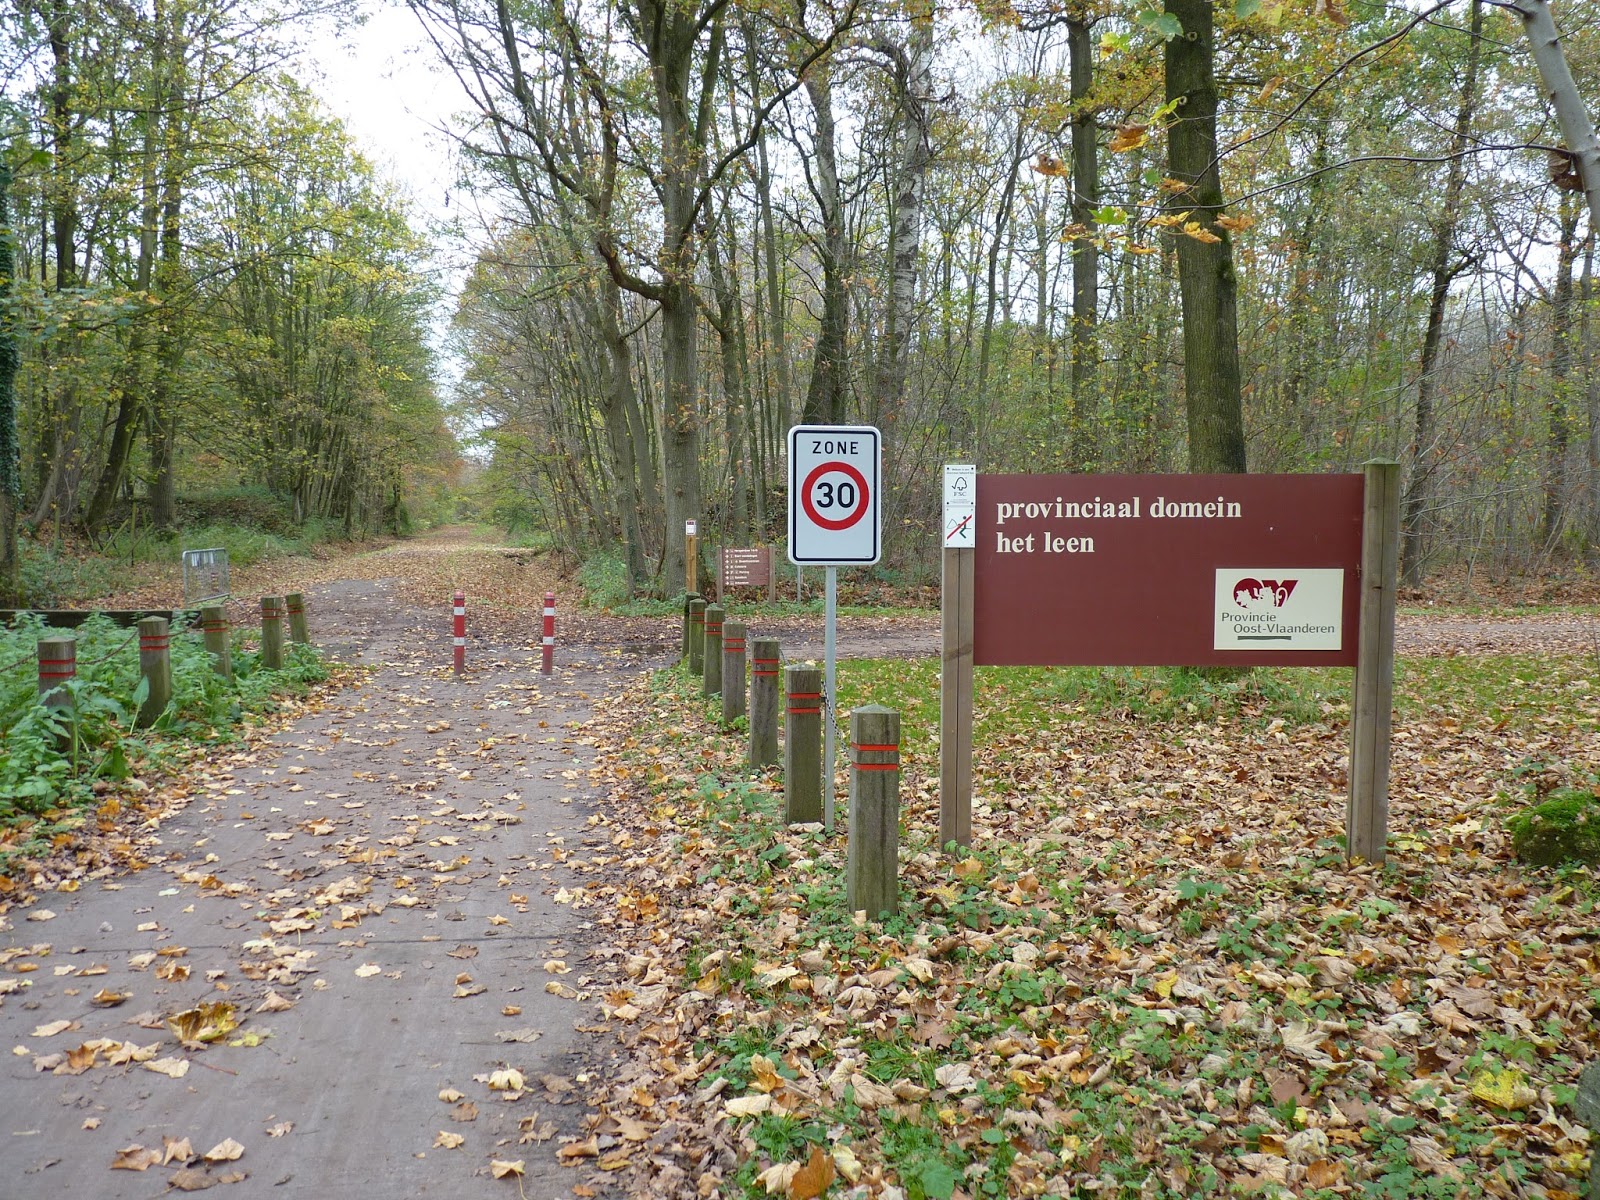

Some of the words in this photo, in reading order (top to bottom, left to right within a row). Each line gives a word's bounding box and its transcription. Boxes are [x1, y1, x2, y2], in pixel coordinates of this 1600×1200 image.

[812, 441, 859, 454] ZONE
[816, 482, 855, 509] 30
[996, 496, 1141, 524] provinciaal
[1150, 496, 1242, 518] domein
[996, 532, 1035, 553] het
[1044, 532, 1095, 553] leen
[1221, 611, 1277, 622] Provincie
[1233, 623, 1335, 634] Oost-Vlaanderen
